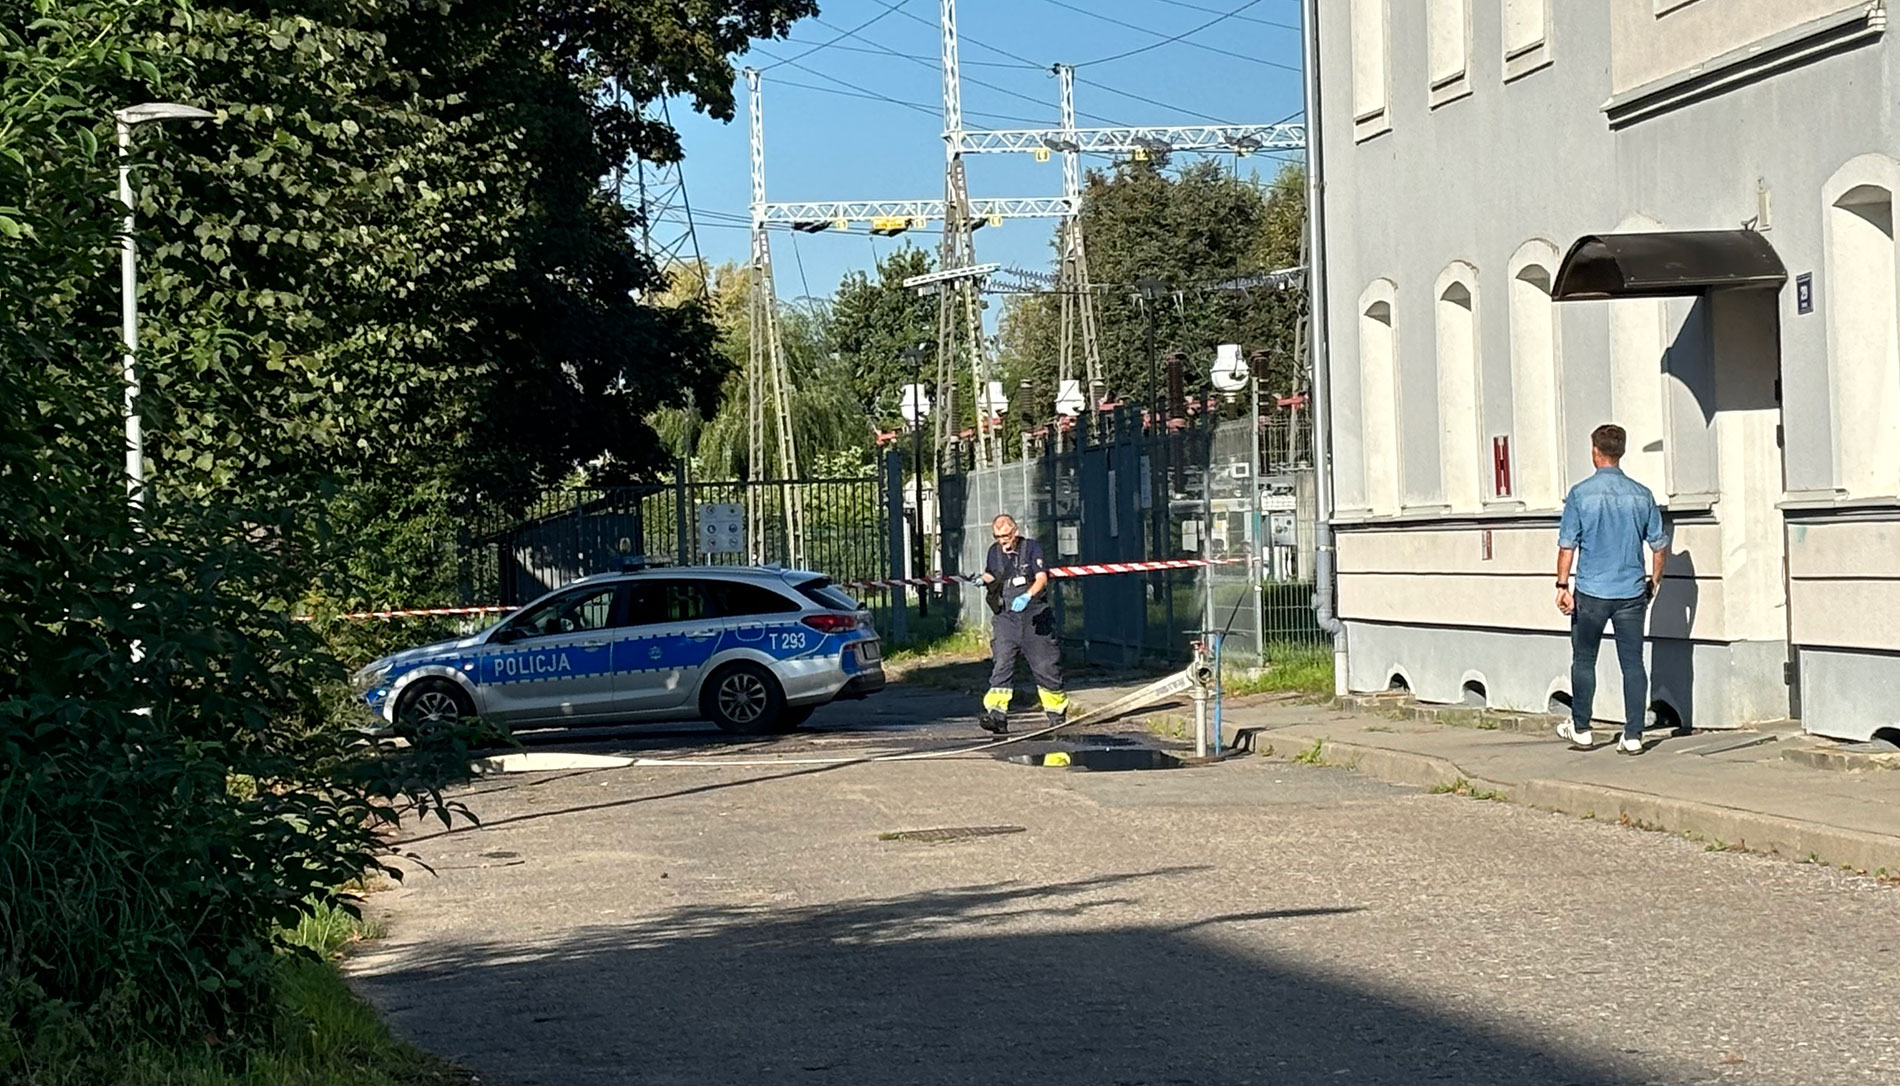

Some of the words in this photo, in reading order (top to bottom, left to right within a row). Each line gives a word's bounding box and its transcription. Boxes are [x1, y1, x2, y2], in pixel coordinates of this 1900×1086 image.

[769, 633, 778, 650] T
[782, 632, 806, 649] 293
[494, 653, 571, 677] POLICJA
